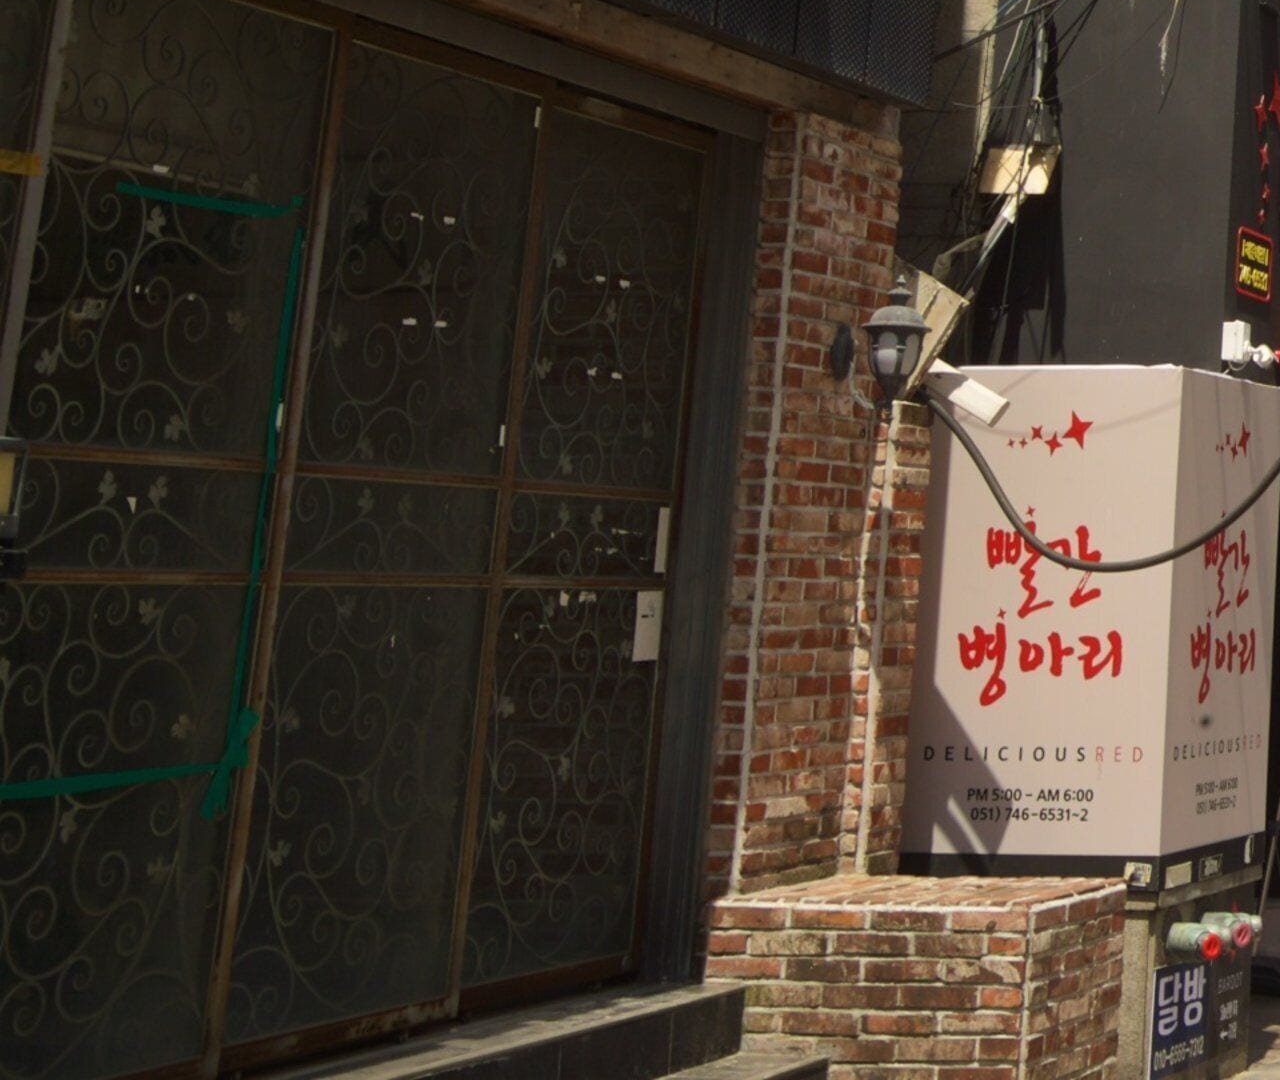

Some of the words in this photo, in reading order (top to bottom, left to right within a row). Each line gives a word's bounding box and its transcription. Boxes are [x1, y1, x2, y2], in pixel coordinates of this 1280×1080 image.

[985, 522, 1102, 620] 빨간
[1203, 528, 1250, 619] 빨간
[957, 623, 1123, 707] 병아리
[1189, 623, 1257, 705] 병아리
[967, 789, 989, 802] PM
[991, 789, 1023, 803] 5:00
[1036, 789, 1061, 802] AM
[1063, 789, 1094, 803] 6:00
[970, 808, 1001, 823] 051)
[1006, 808, 1089, 822] 746-6531~2
[1158, 964, 1207, 1036] 달방
